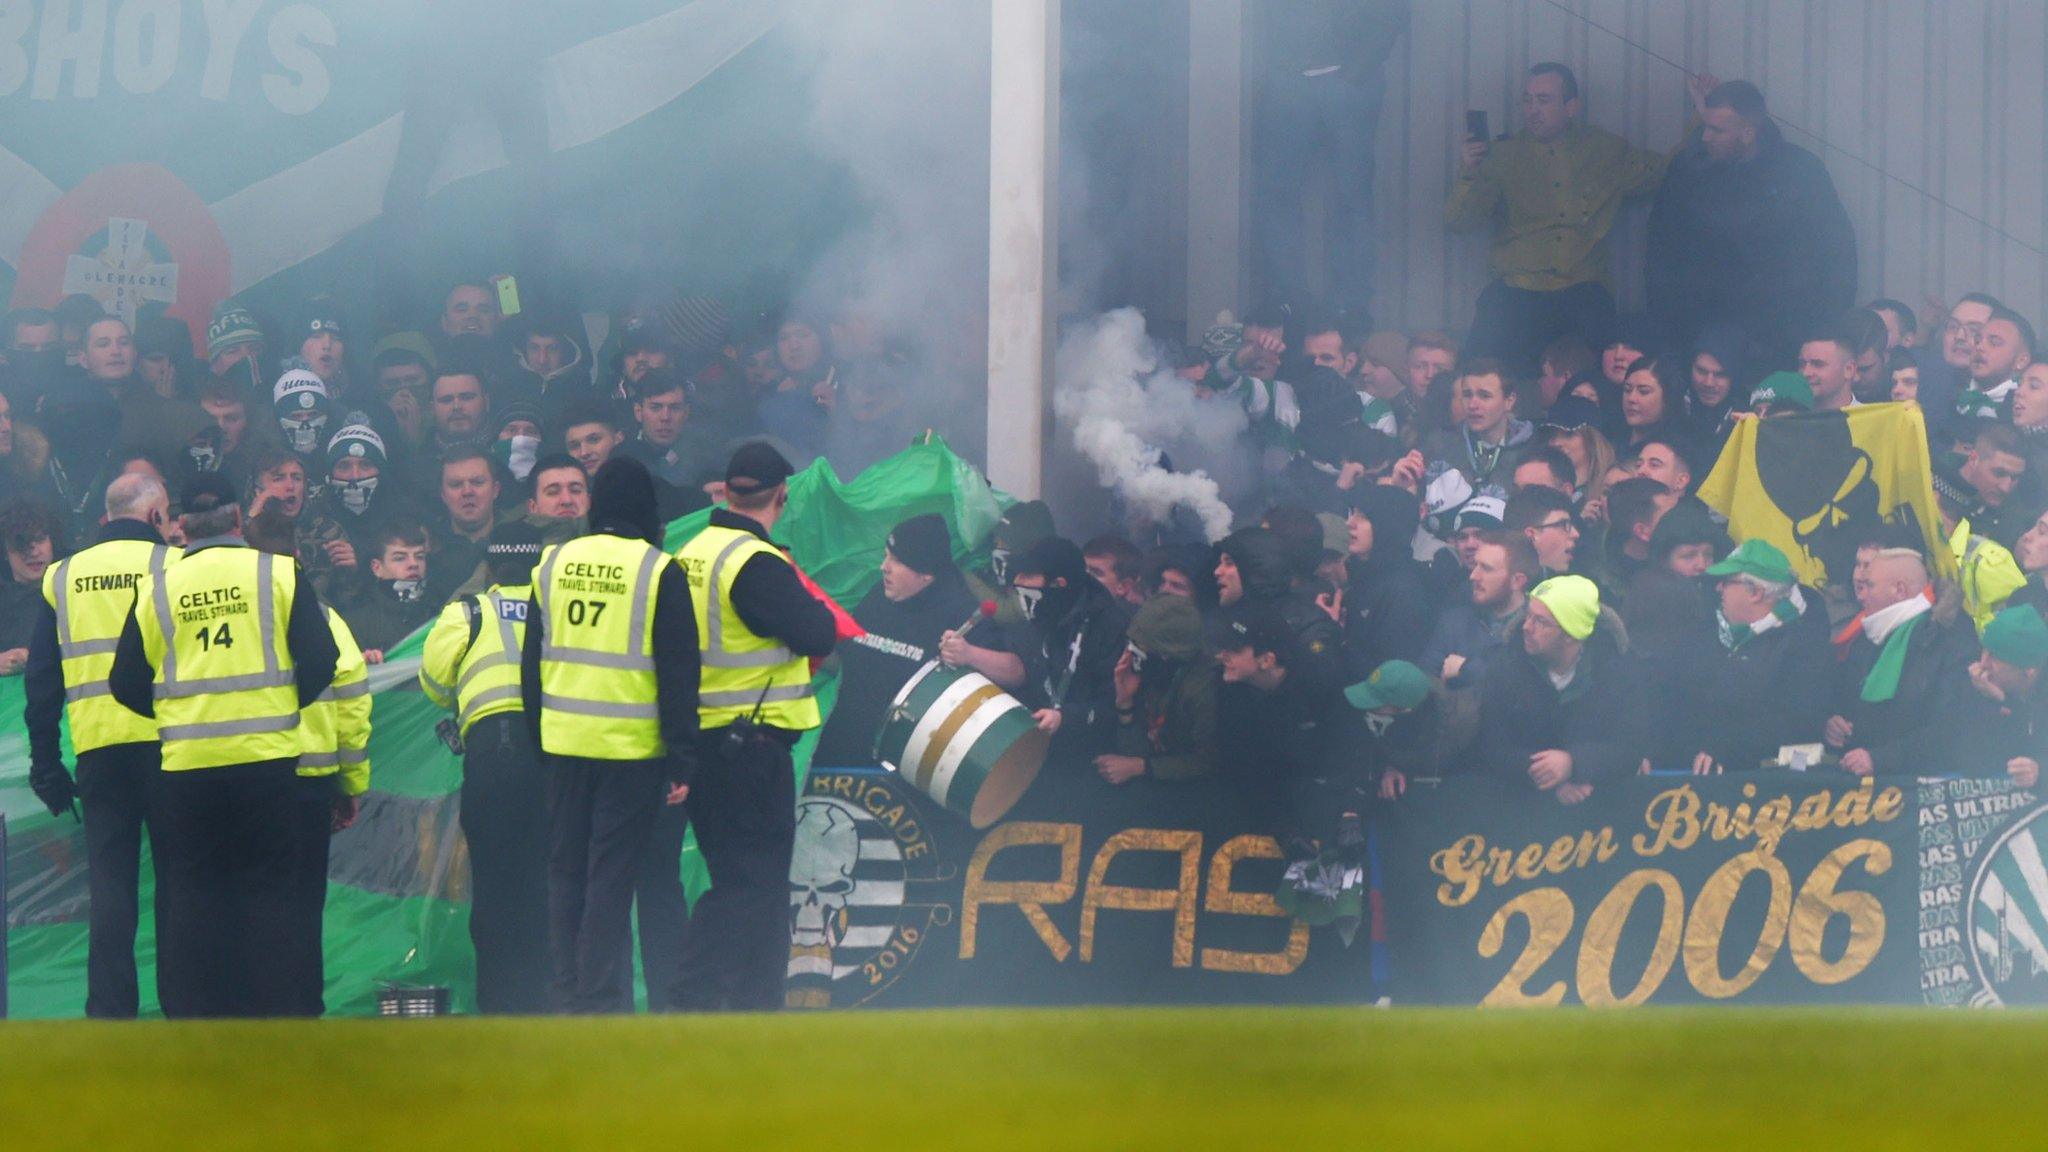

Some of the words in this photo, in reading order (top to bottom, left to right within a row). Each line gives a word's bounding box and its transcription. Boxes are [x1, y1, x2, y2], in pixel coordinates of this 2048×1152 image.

[564, 562, 624, 580] CELTIC
[179, 585, 242, 609] CELTIC
[210, 601, 250, 619] STEWARD
[567, 598, 608, 627] 07
[177, 608, 209, 624] TRAVEL
[194, 621, 235, 653] 14
[812, 775, 929, 861] BRIGADE
[1918, 803, 1949, 826] AS
[1953, 791, 2038, 820] ULTRAS
[1430, 825, 1619, 907] Green
[1632, 776, 1904, 855] Brigade
[957, 820, 1311, 975] RAS
[1919, 883, 1963, 908] RAS
[1477, 839, 1893, 1008] 2006
[862, 925, 920, 986] 2016
